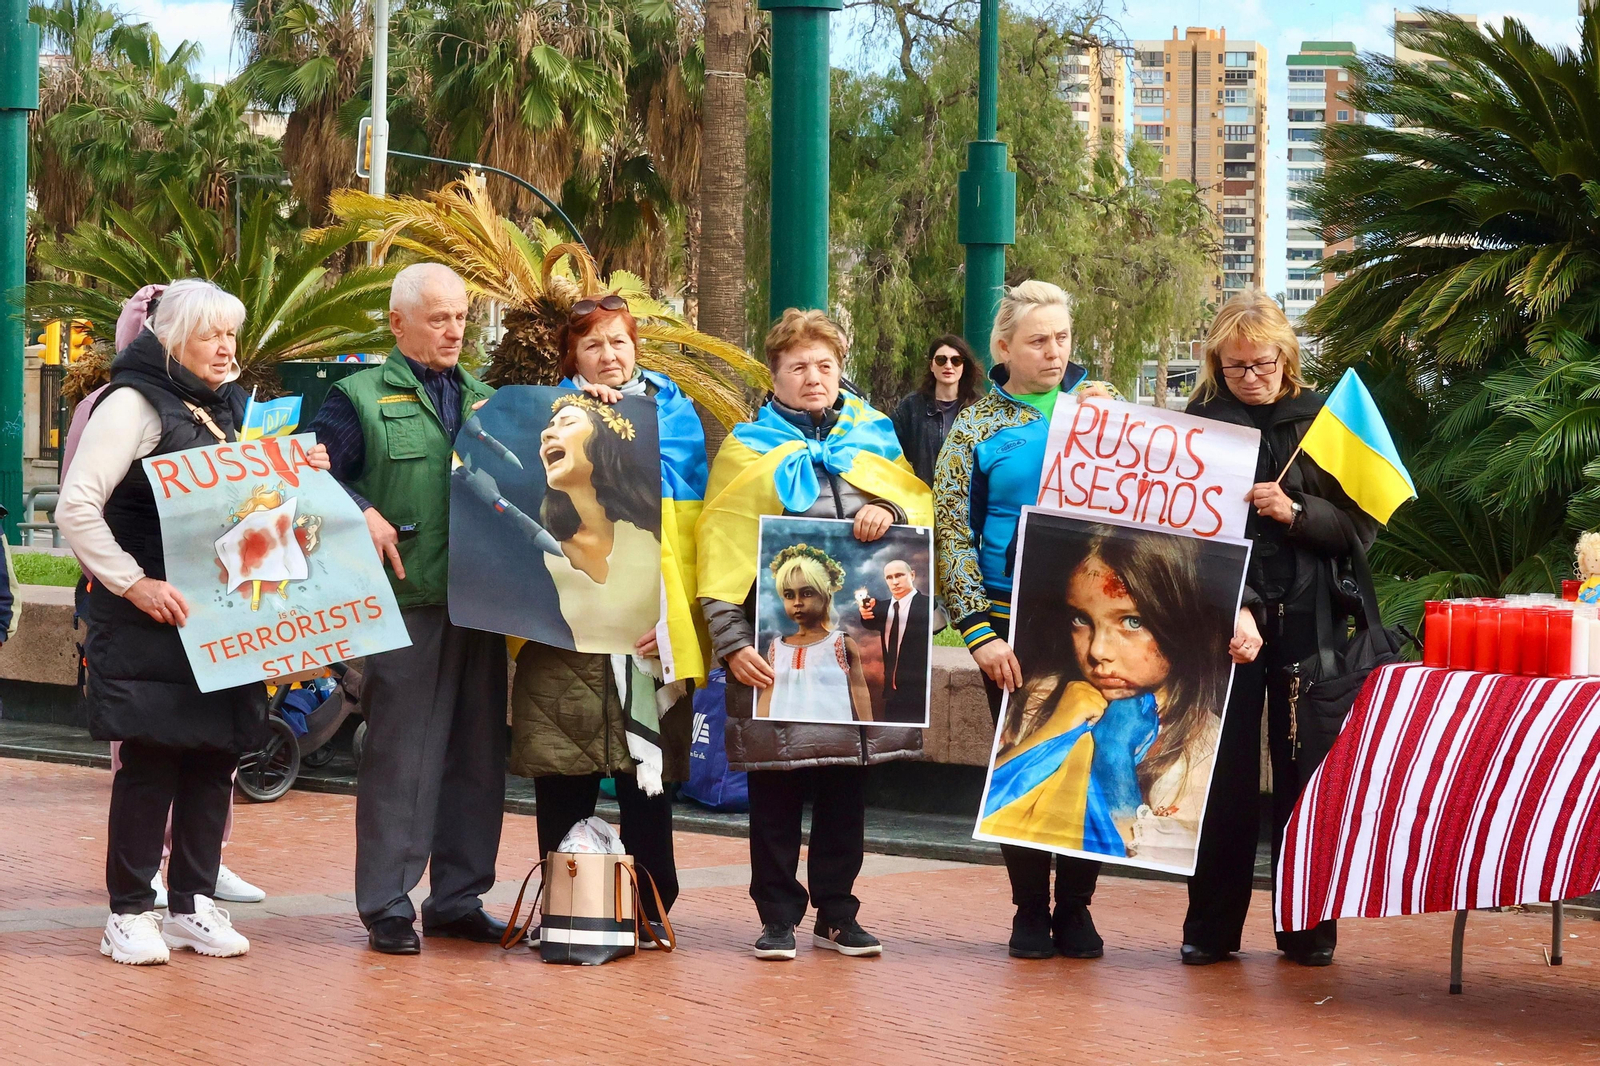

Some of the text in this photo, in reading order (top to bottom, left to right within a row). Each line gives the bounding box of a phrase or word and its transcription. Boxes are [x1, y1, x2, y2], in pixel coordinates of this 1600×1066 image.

[151, 437, 320, 498] RUSSIA
[1063, 402, 1205, 481] RUSOS
[200, 595, 383, 663] TERRORISTS
[278, 611, 287, 620] is
[262, 639, 356, 678] STATE
